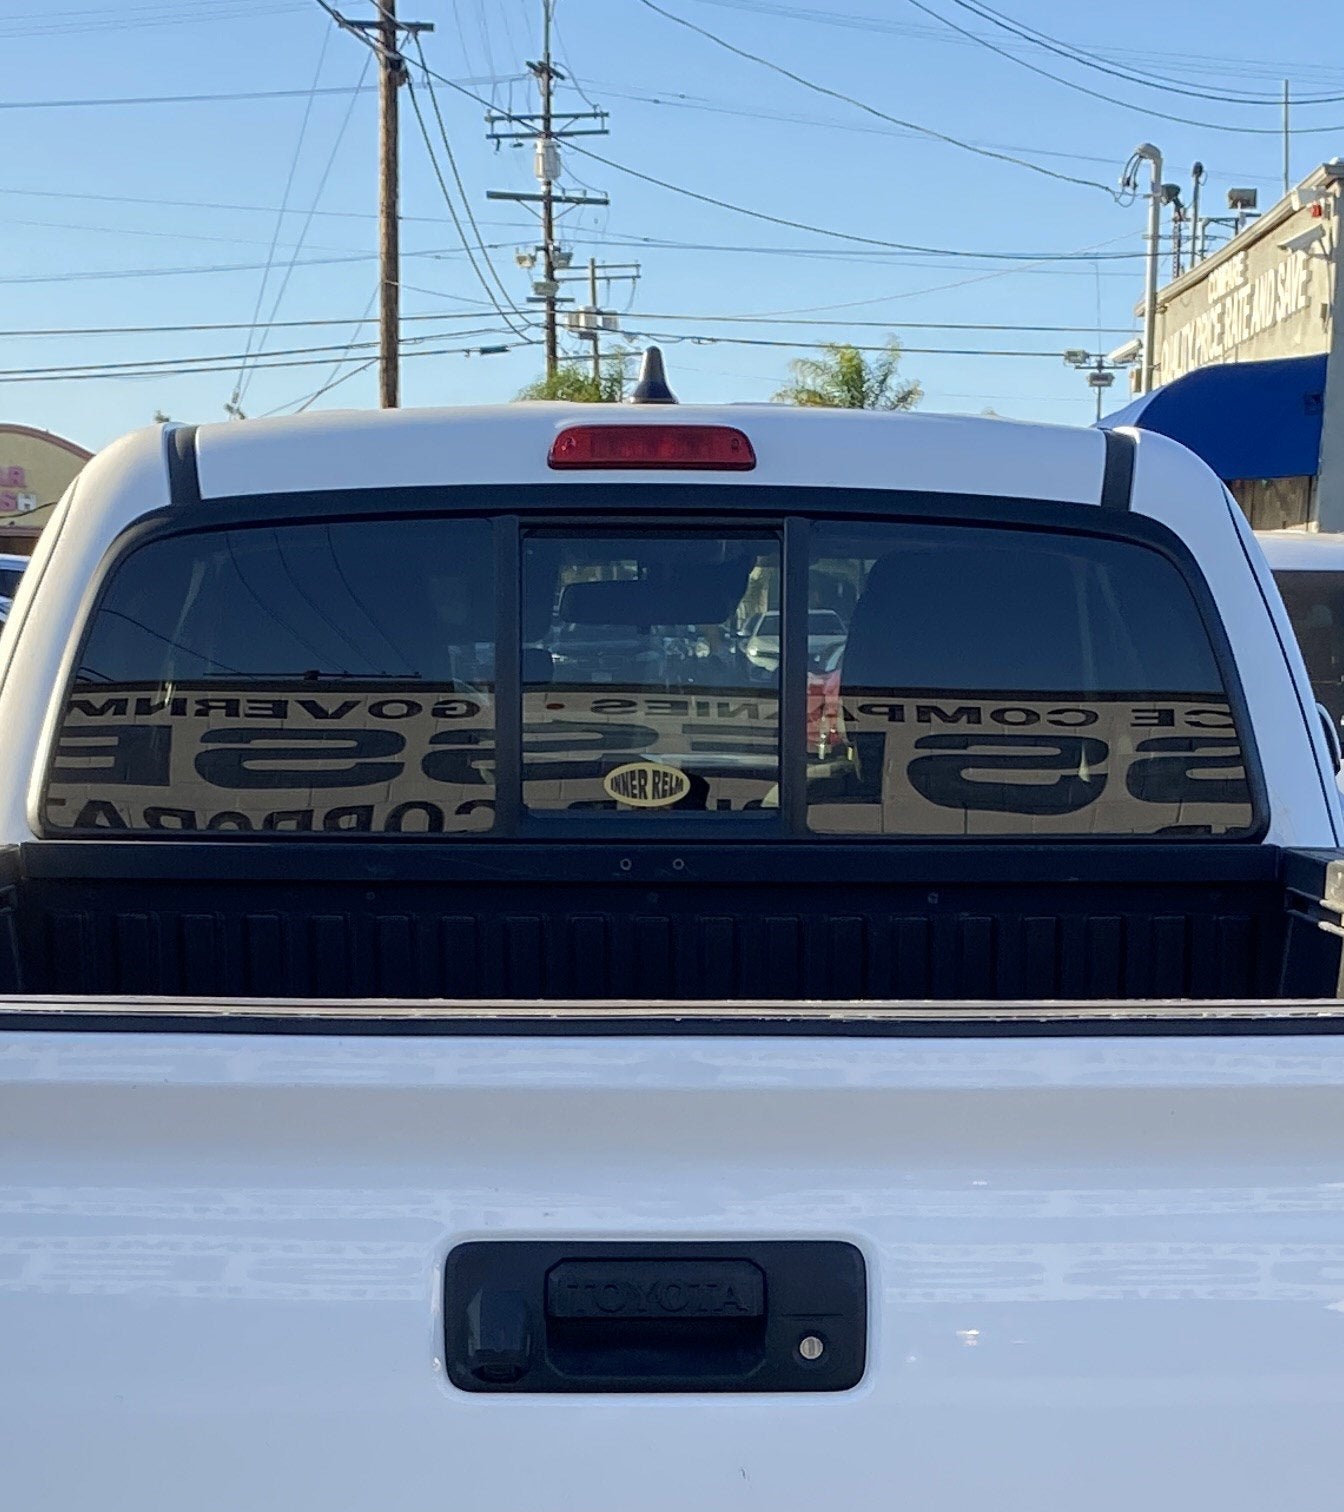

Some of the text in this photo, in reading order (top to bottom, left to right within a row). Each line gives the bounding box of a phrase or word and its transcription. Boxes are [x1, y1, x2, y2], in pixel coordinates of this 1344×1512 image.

[1250, 269, 1275, 337] AND
[1275, 250, 1307, 322] SAVE
[610, 769, 648, 800] INNER
[564, 1283, 750, 1314] TOYOTA
